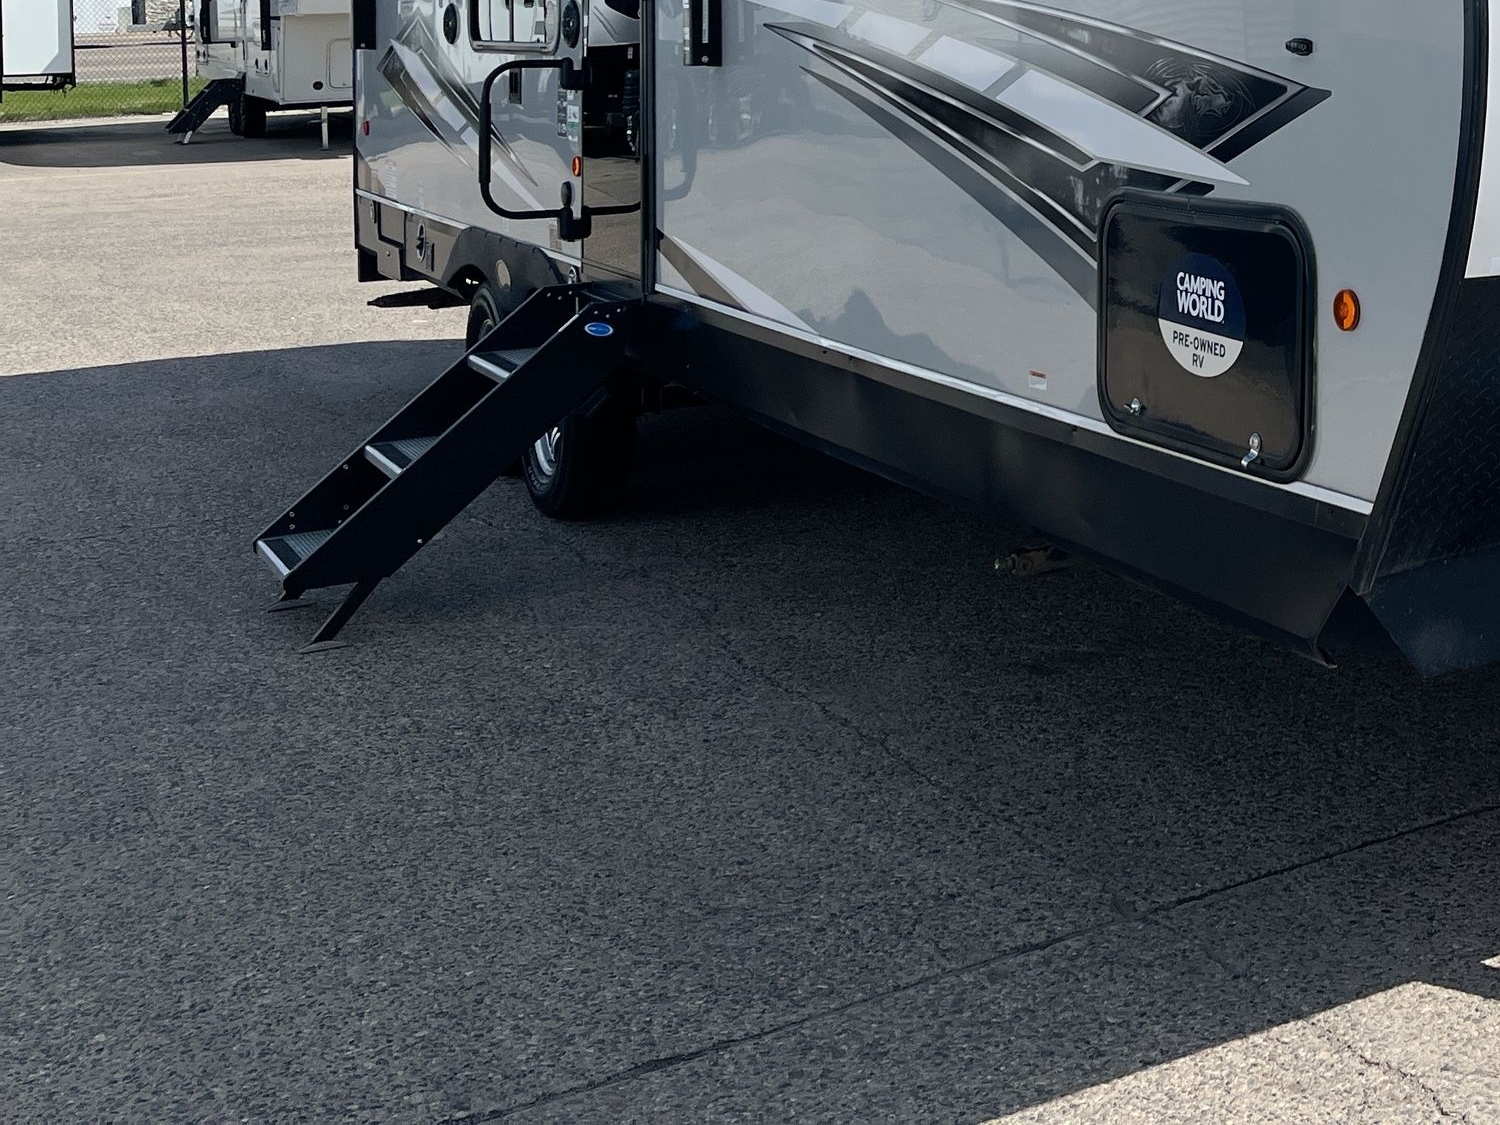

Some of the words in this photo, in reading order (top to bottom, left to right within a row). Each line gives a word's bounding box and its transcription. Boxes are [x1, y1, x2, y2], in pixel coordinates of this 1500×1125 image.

[1176, 271, 1225, 301] CAMPING
[1176, 289, 1225, 324] WORLD
[1172, 330, 1226, 358] PRE-OWNED
[1192, 353, 1205, 368] RV
